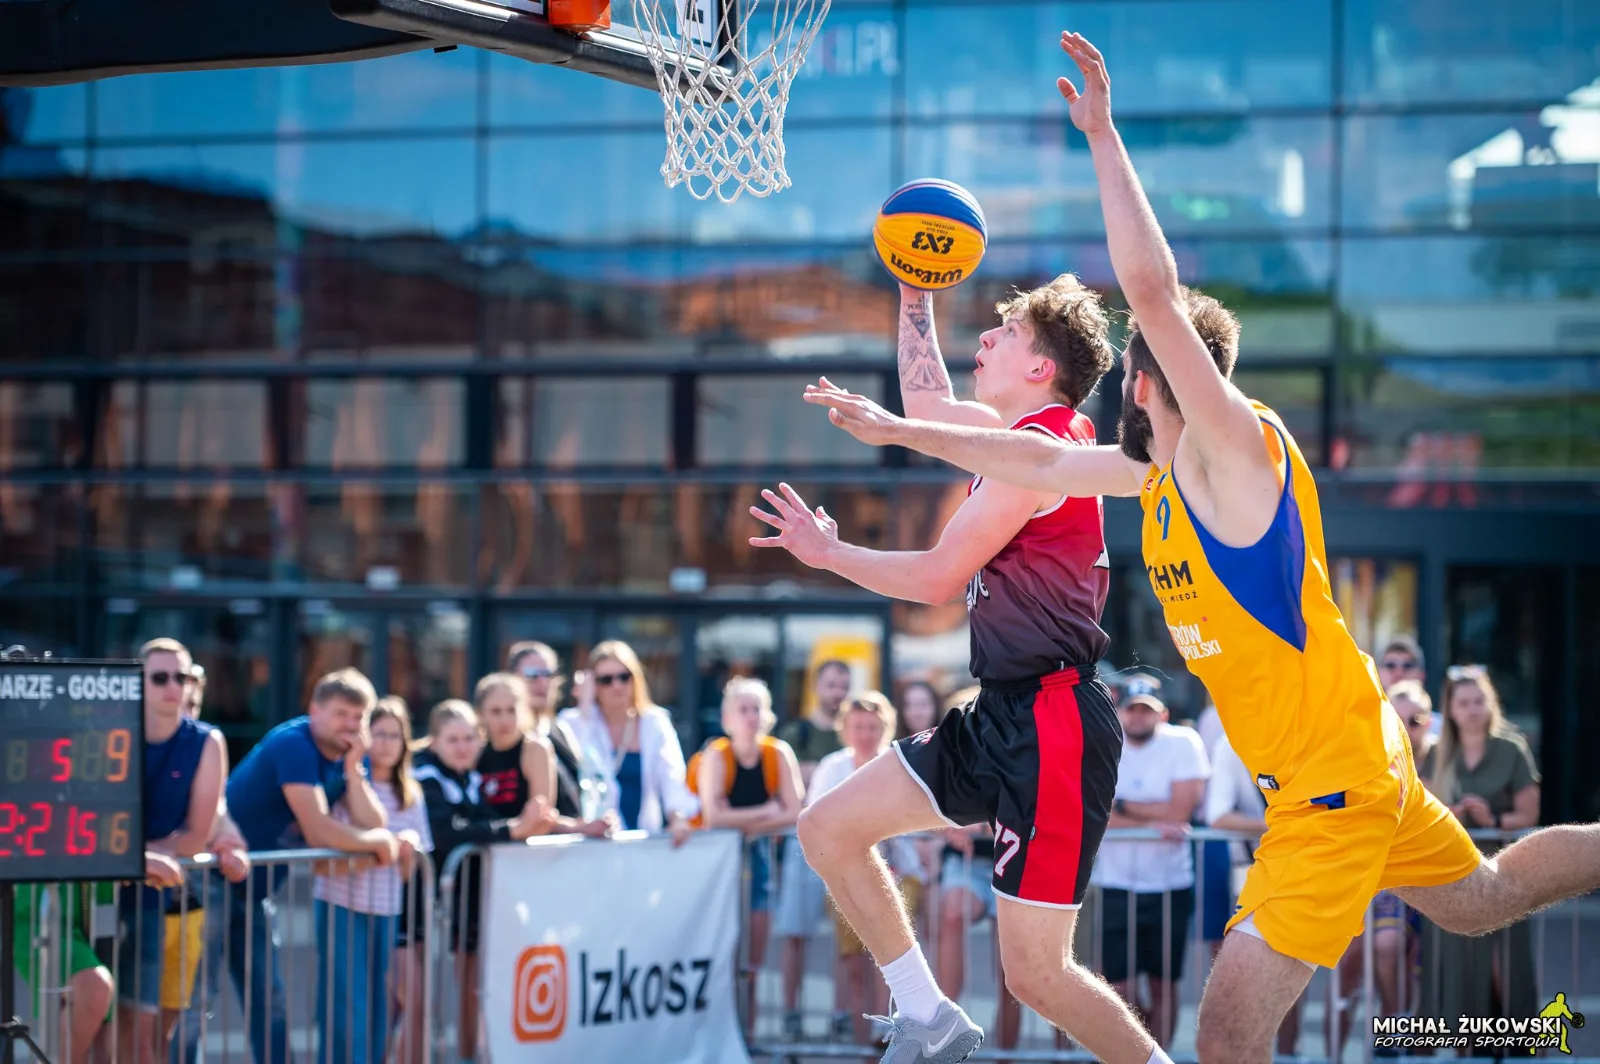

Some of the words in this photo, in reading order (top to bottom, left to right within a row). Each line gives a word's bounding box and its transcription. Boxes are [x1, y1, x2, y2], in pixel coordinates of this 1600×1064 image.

[891, 253, 963, 284] Wilson
[1147, 560, 1194, 591] HM
[1167, 620, 1203, 646] RÓW
[0, 674, 54, 700] ARZE
[68, 667, 142, 701] GOŚCIE
[51, 738, 73, 783] 5
[105, 728, 131, 783] 9
[109, 811, 130, 855] 6
